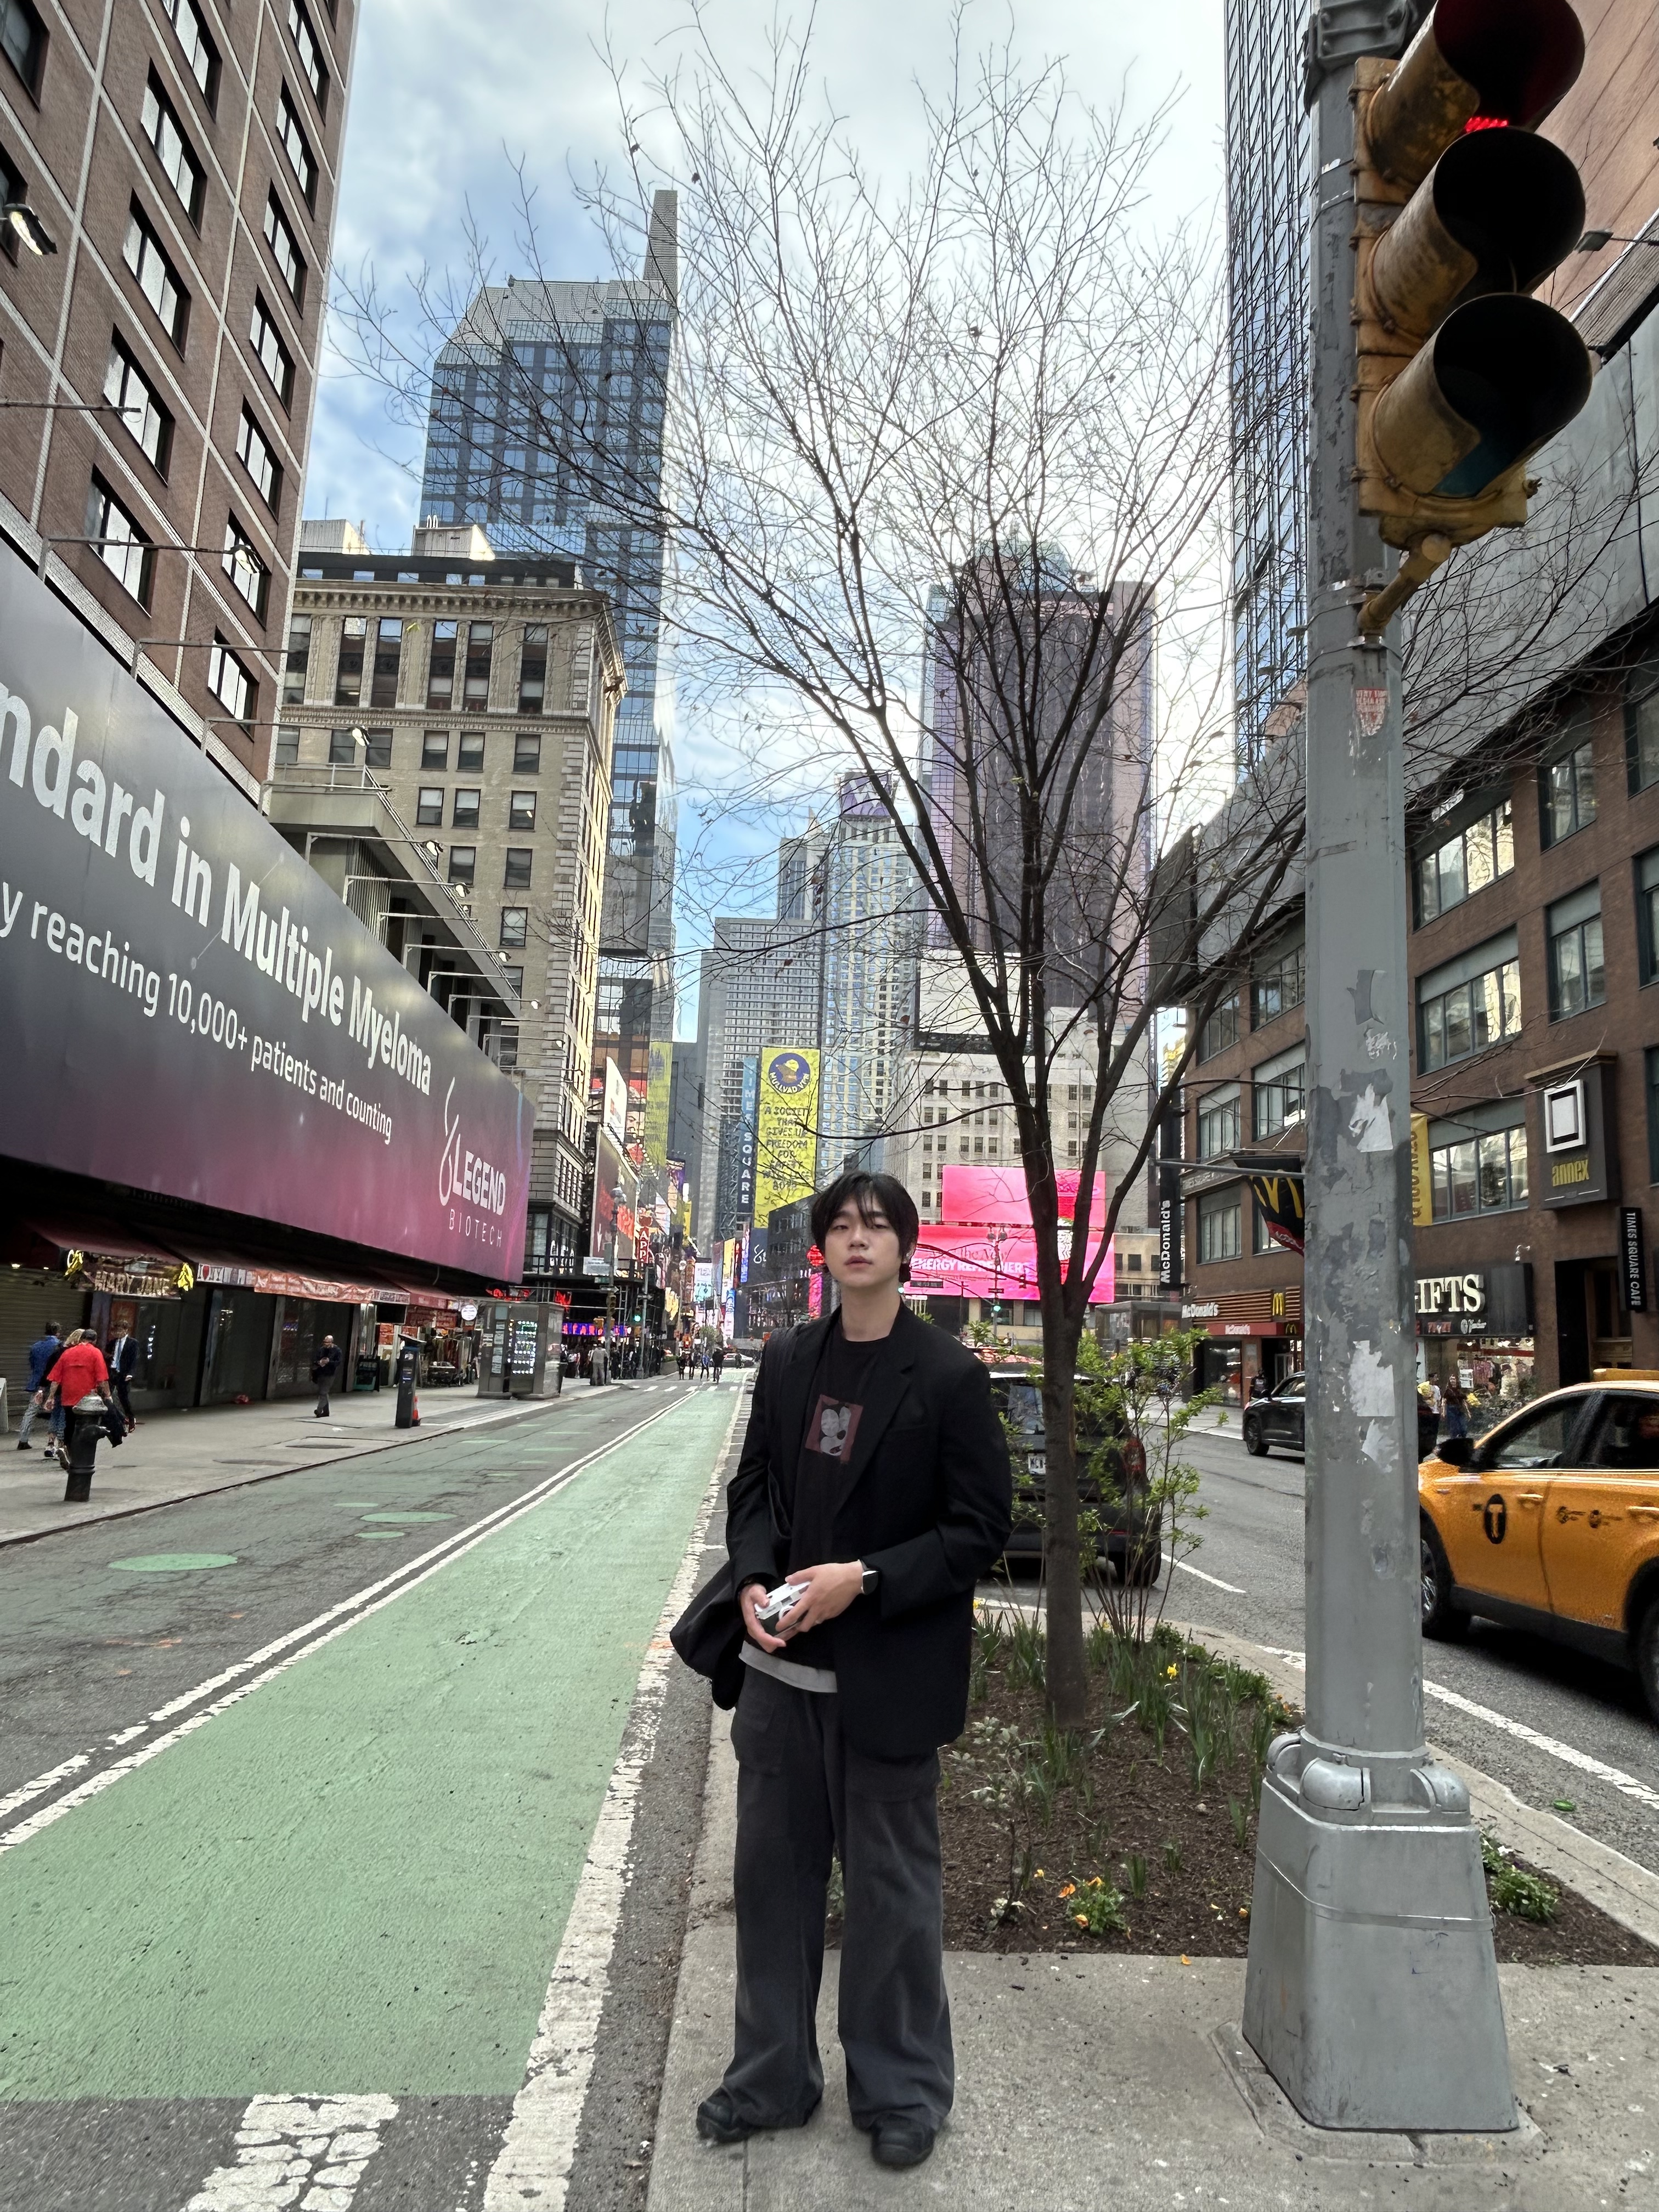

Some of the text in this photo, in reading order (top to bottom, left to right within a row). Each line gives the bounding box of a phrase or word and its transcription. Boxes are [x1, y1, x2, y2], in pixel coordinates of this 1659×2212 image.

[0, 682, 431, 1096] ndard in Multiple Myeloma
[0, 882, 392, 1145] y reaching 10,000+ patients and counting
[769, 1071, 810, 1093] MULLVAD VPN
[766, 1127, 793, 1136] GIVES
[766, 1139, 808, 1149] FREEDOM
[452, 1133, 506, 1216] LEGEND
[741, 1132, 753, 1204] SQUARE
[1552, 1159, 1589, 1187] annex
[449, 1209, 502, 1248] BIOTECH
[1160, 1200, 1171, 1284] McDonald's
[1626, 1212, 1637, 1239] TIMES
[1628, 1240, 1639, 1278] SQUARE
[1414, 1274, 1486, 1314] IFTS
